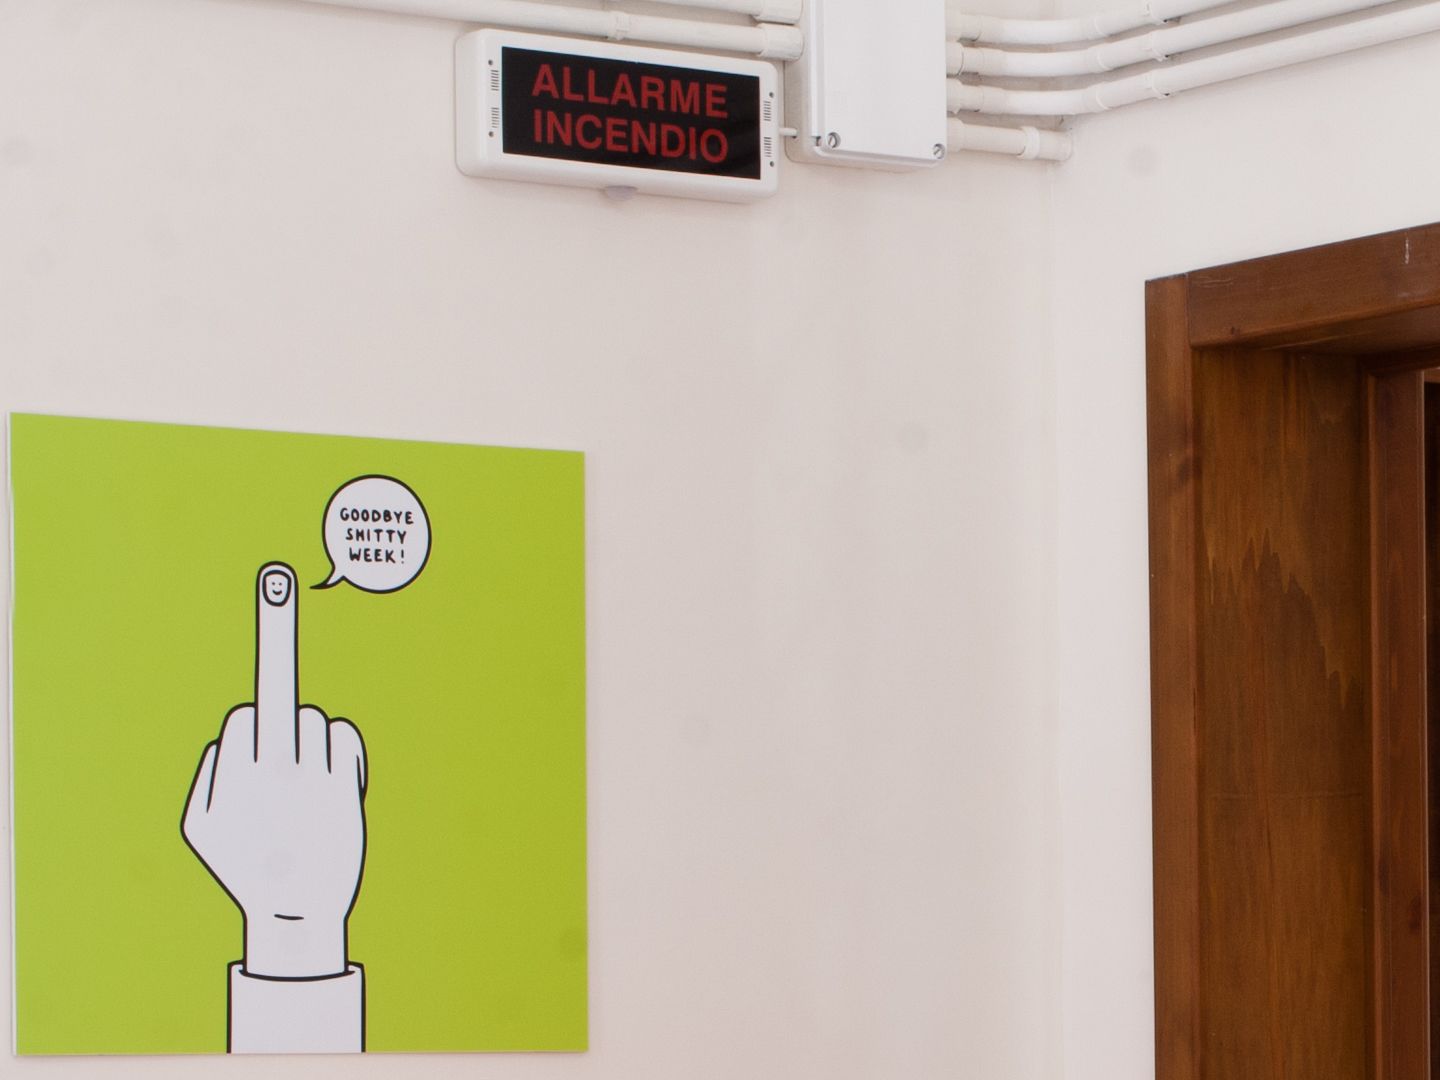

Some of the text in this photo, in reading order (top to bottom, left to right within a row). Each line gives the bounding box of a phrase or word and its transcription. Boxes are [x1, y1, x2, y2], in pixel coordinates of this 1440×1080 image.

[533, 64, 728, 119] ALLARME
[534, 110, 728, 163] INCENDIO
[340, 507, 414, 524] GOODBYE
[345, 528, 407, 544] SHITTY
